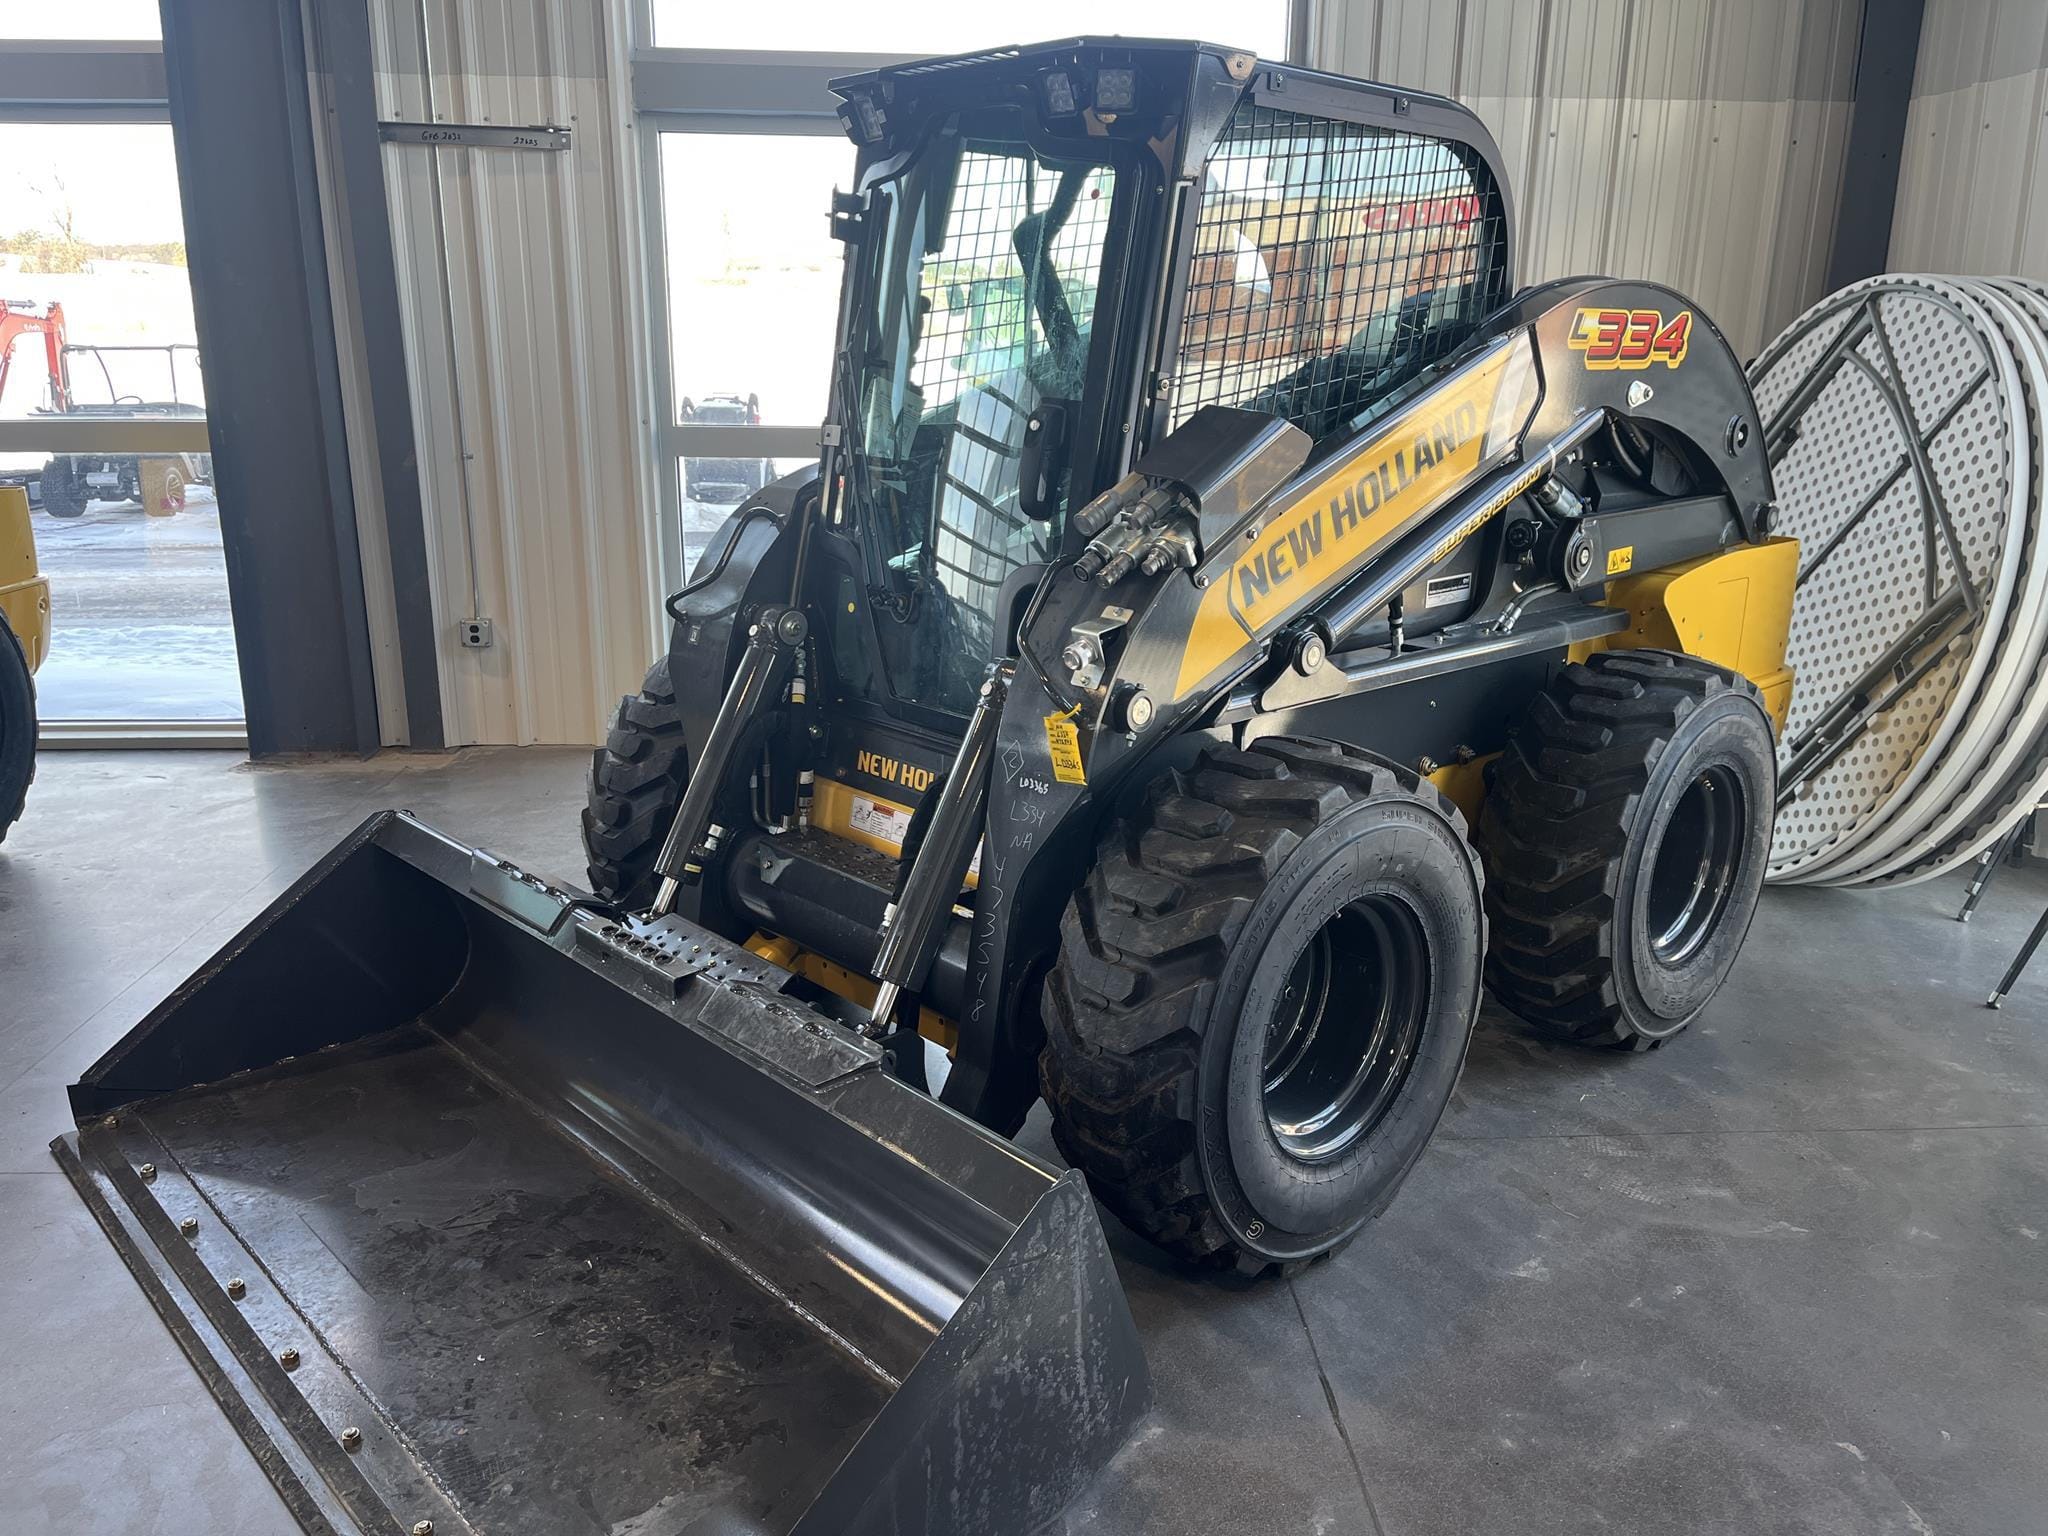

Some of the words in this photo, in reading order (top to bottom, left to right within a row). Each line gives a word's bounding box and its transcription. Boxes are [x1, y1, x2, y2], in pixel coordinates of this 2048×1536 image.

[1568, 308, 1692, 370] L334
[1238, 509, 1323, 608] NEW
[1330, 400, 1477, 540] HOLLAND
[857, 750, 898, 782] NEW
[1010, 800, 1046, 828] L334
